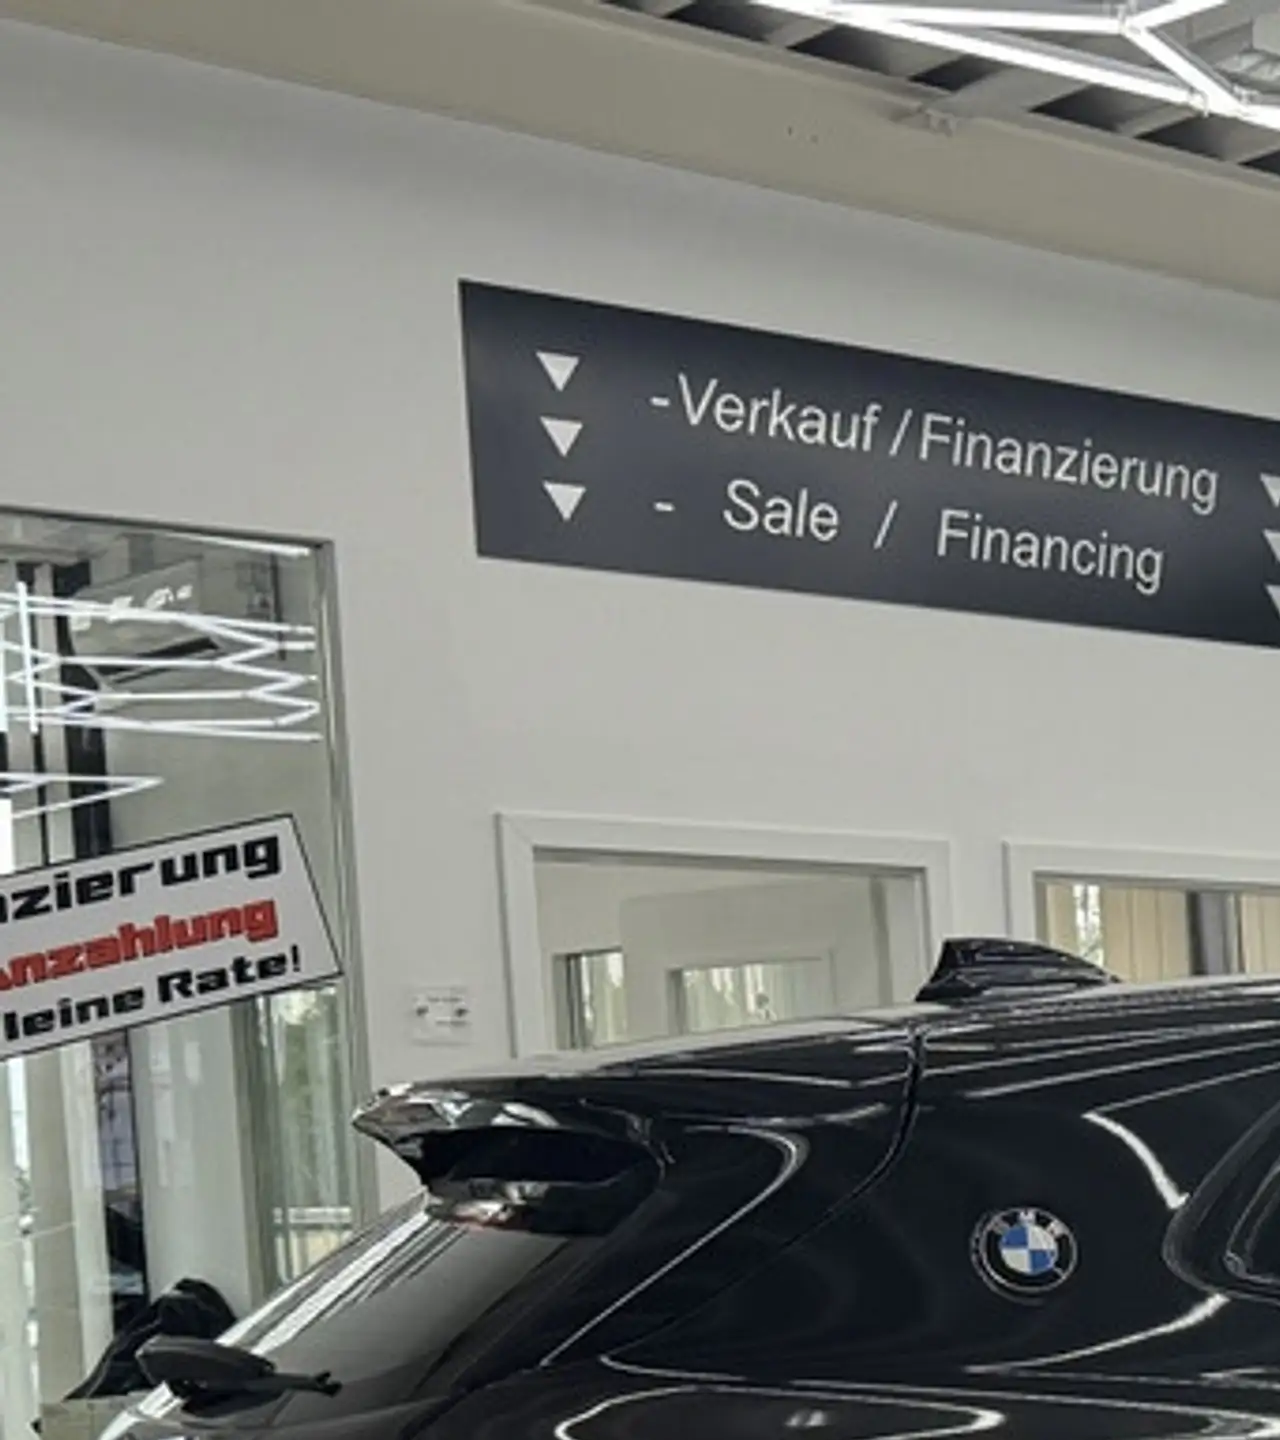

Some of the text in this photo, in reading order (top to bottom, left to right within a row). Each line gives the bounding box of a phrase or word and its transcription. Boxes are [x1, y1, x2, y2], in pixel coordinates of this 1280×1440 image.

[722, 479, 840, 543] Sale
[874, 500, 898, 550] /
[937, 510, 1165, 595] Financing
[0, 836, 281, 924] zierung
[157, 945, 302, 1003] Rate!
